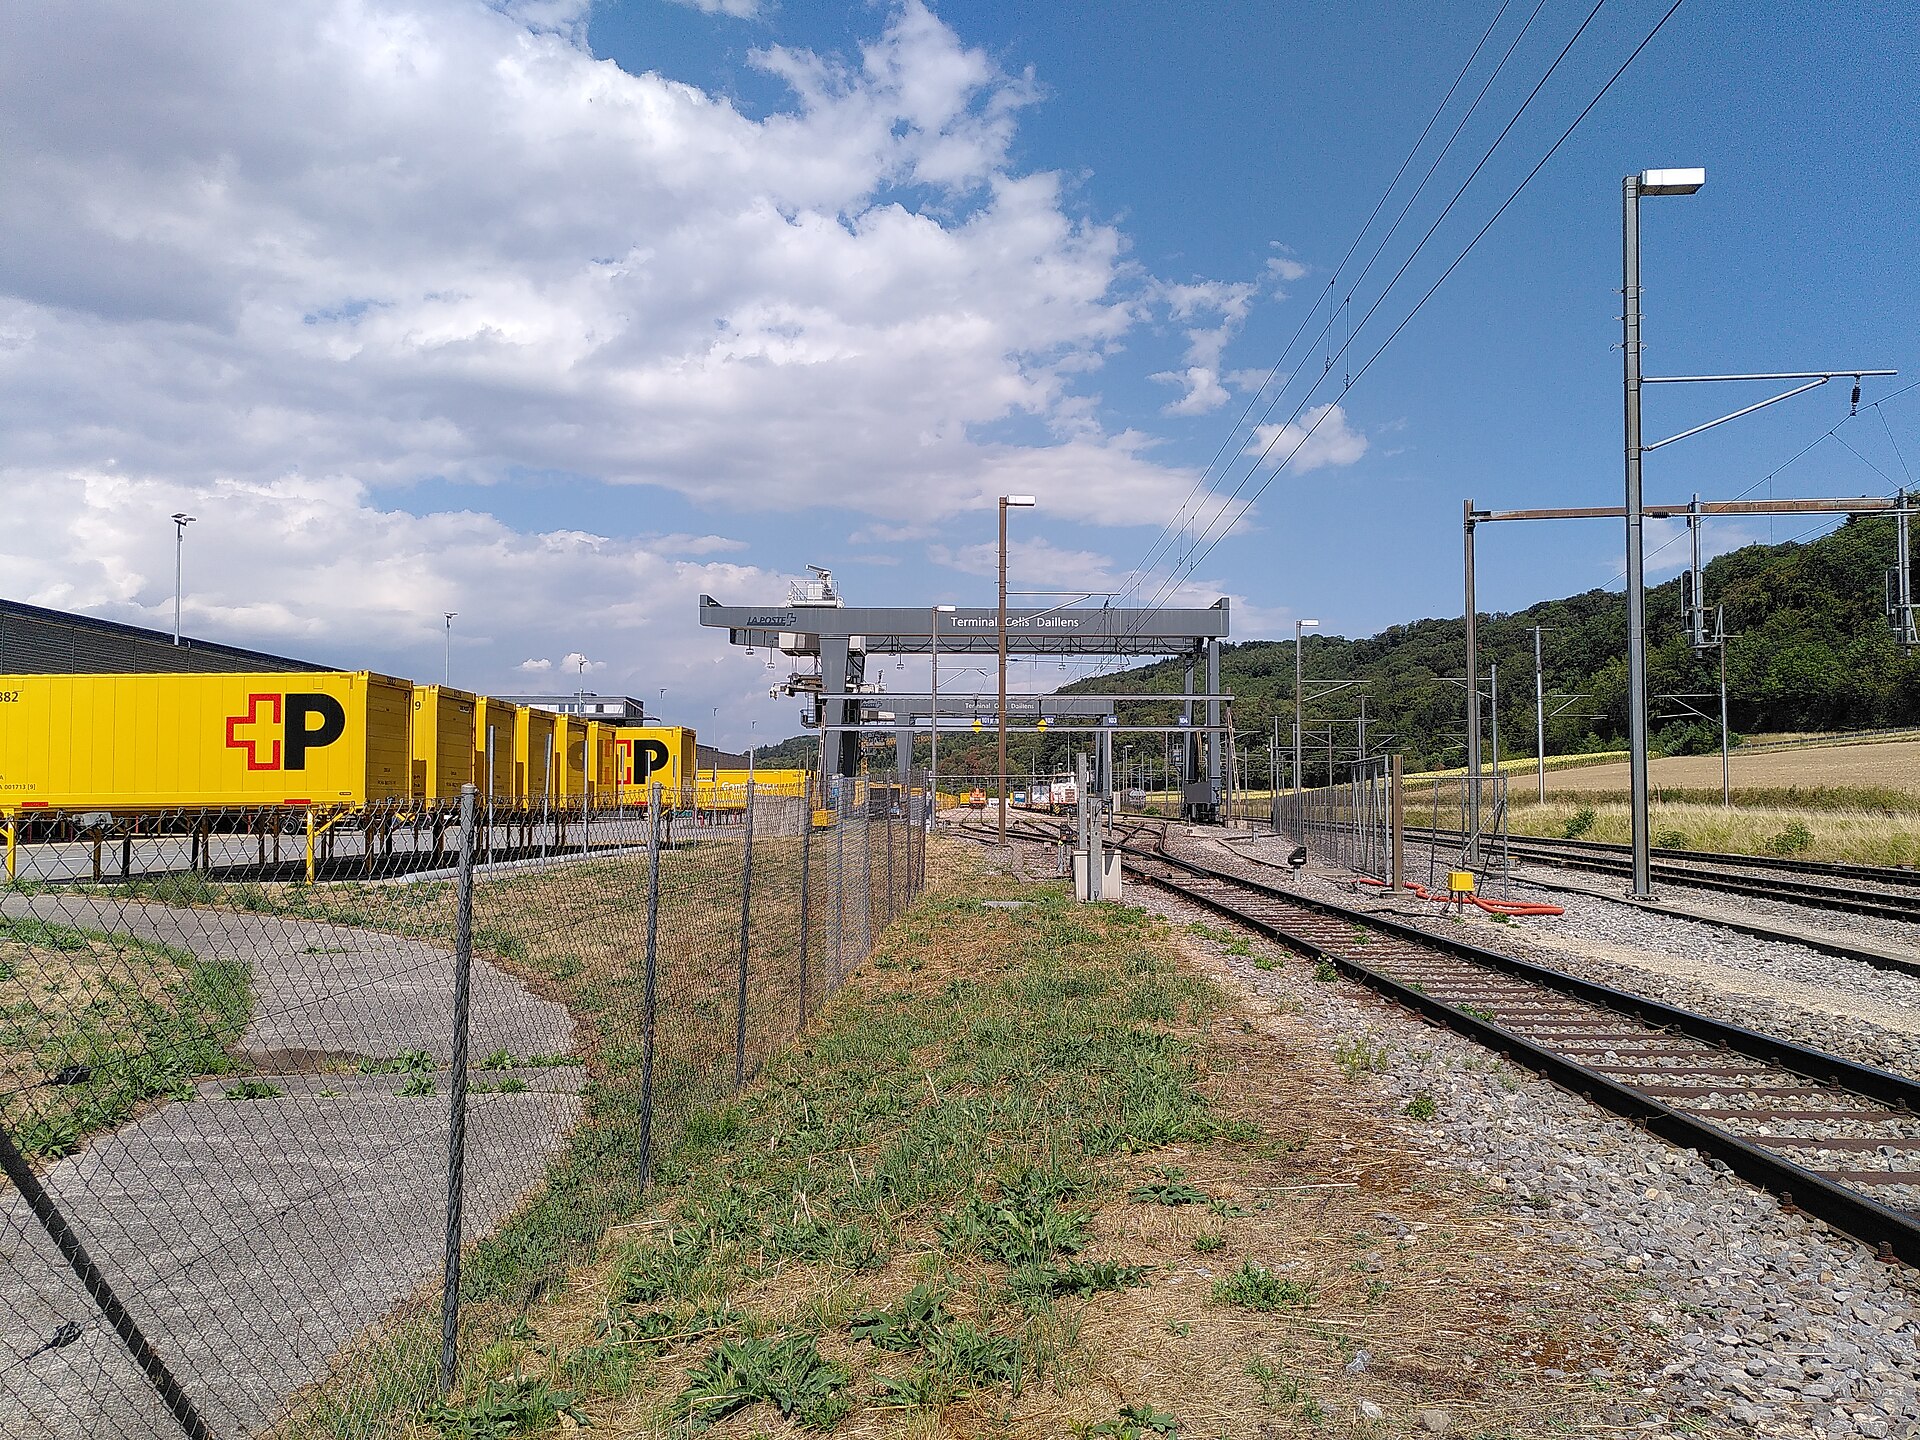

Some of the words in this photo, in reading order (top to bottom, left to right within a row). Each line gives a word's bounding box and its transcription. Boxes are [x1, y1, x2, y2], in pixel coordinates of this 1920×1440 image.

[747, 616, 758, 626] LA
[760, 616, 786, 626] POSTE
[950, 616, 998, 627] Terminal
[1036, 616, 1079, 627] Daillens
[284, 693, 346, 770] P
